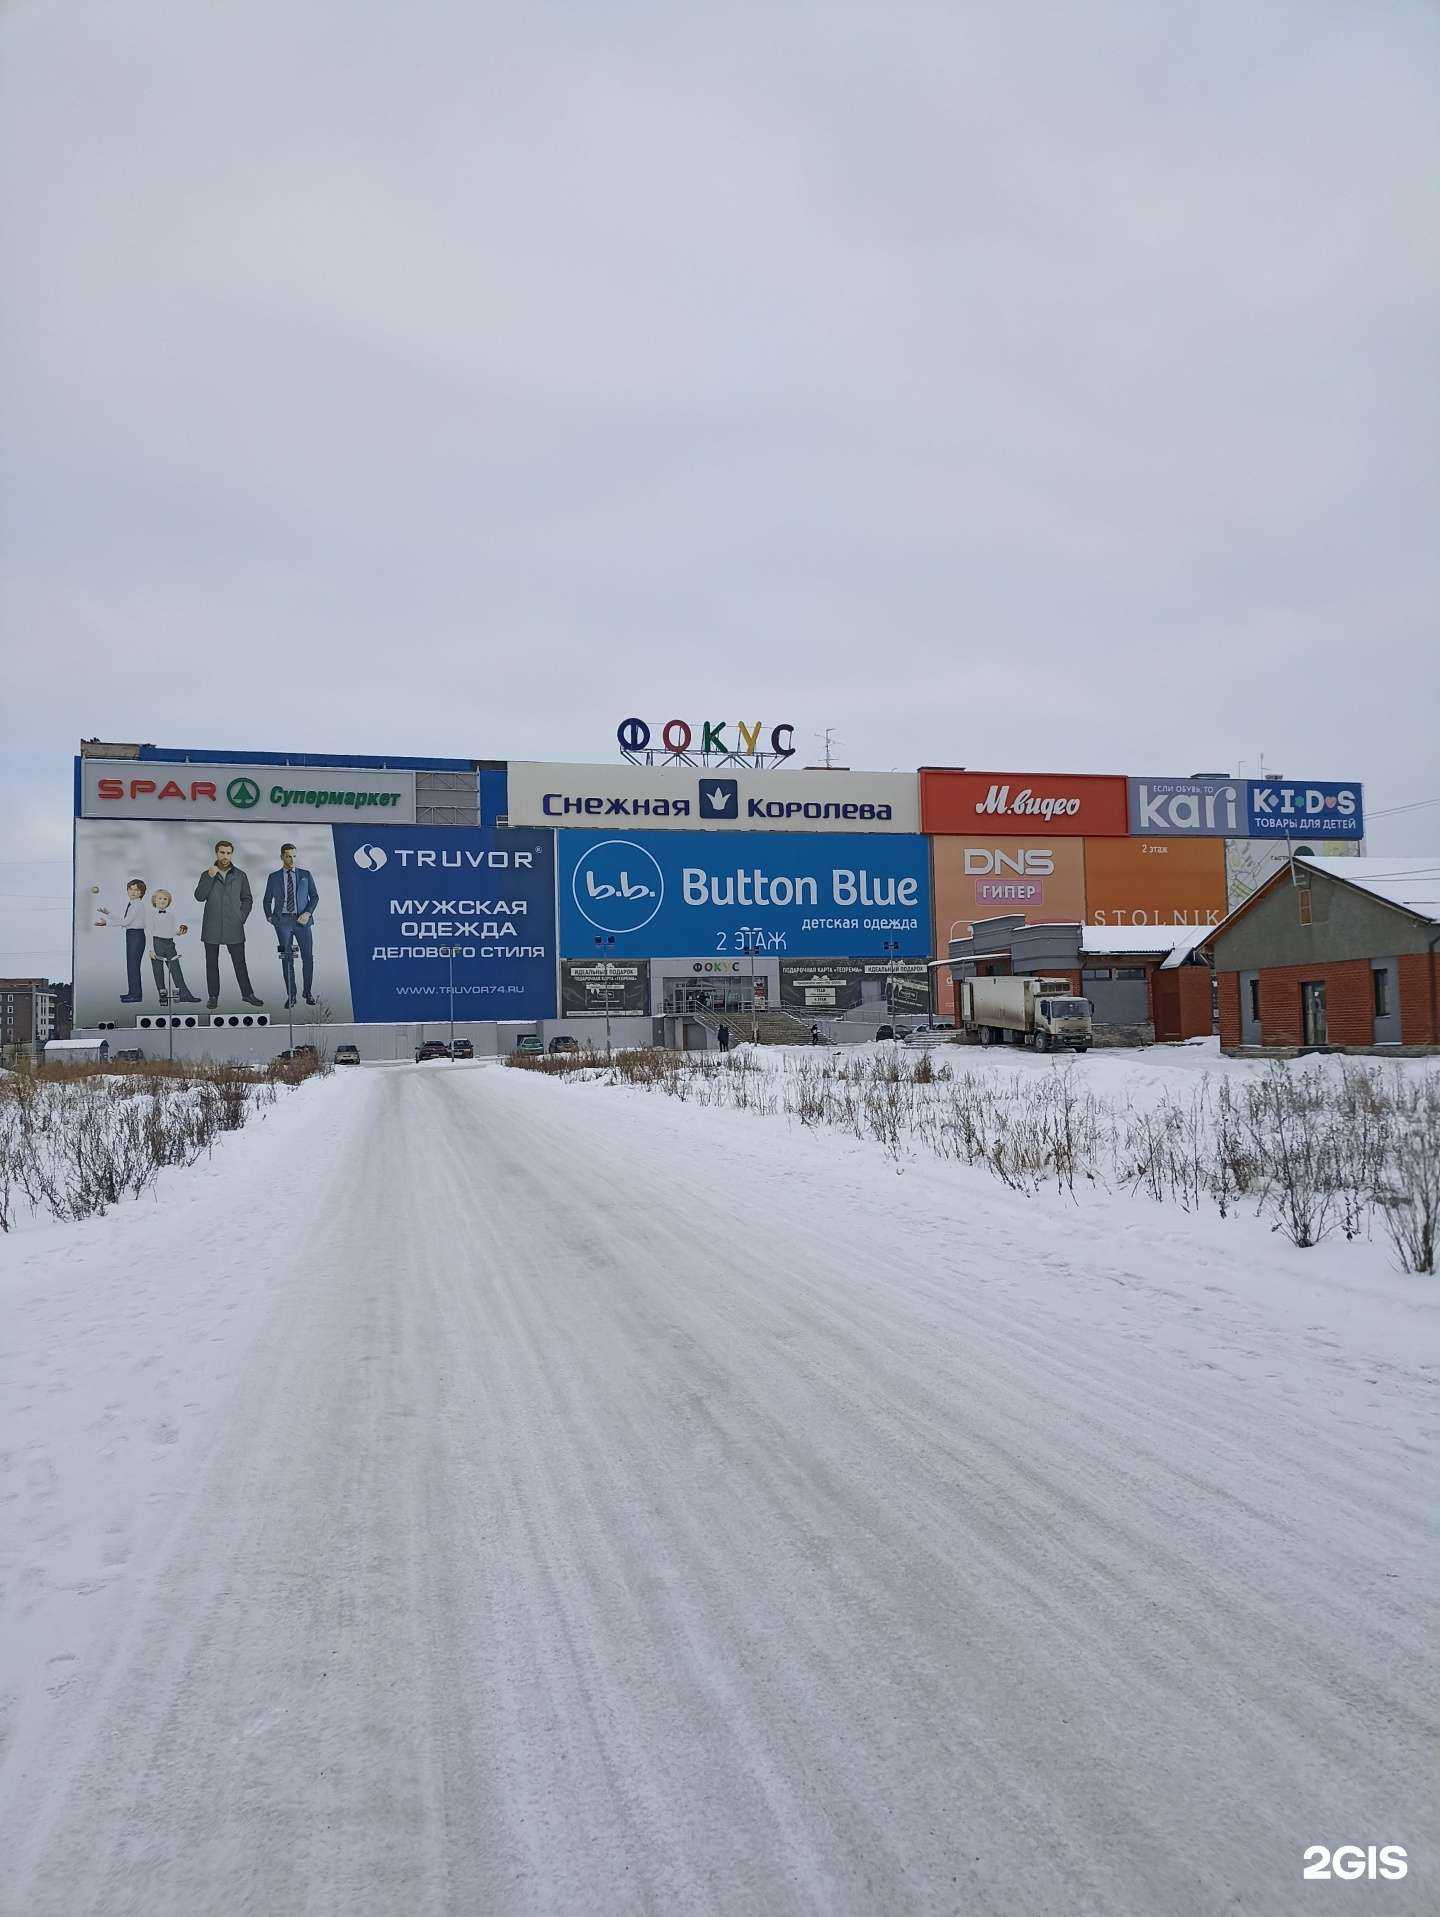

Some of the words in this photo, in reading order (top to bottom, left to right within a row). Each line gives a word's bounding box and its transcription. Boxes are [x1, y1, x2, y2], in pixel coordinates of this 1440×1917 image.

[617, 717, 796, 755] ФОКУС
[98, 779, 217, 801] SPAR
[270, 785, 401, 809] Супермаркет
[542, 793, 690, 816] Снежная
[748, 798, 892, 820] Королева
[975, 785, 1080, 821] М.видео
[1140, 785, 1237, 828] kari
[1254, 818, 1298, 828] ТОВАРЫ
[1300, 819, 1321, 829] ДЛЯ
[1323, 818, 1356, 830] ДЕТЕЙ
[963, 848, 1055, 875] DNS
[683, 868, 817, 906] Button
[832, 869, 918, 906] Blue
[982, 884, 1036, 900] ГИПЕР
[389, 900, 527, 915] МУЖСКАЯ
[802, 918, 859, 931] детская
[863, 918, 918, 931] одежда
[1094, 909, 1220, 926] STOLNIK
[401, 922, 518, 939] ОДЕЖДА
[716, 931, 727, 950] 2
[734, 931, 787, 950] ЭТАЖ
[372, 946, 476, 960] ДЕЛОВОГО
[481, 946, 545, 958] СТИЛЯ
[692, 962, 740, 973] ФОКУС
